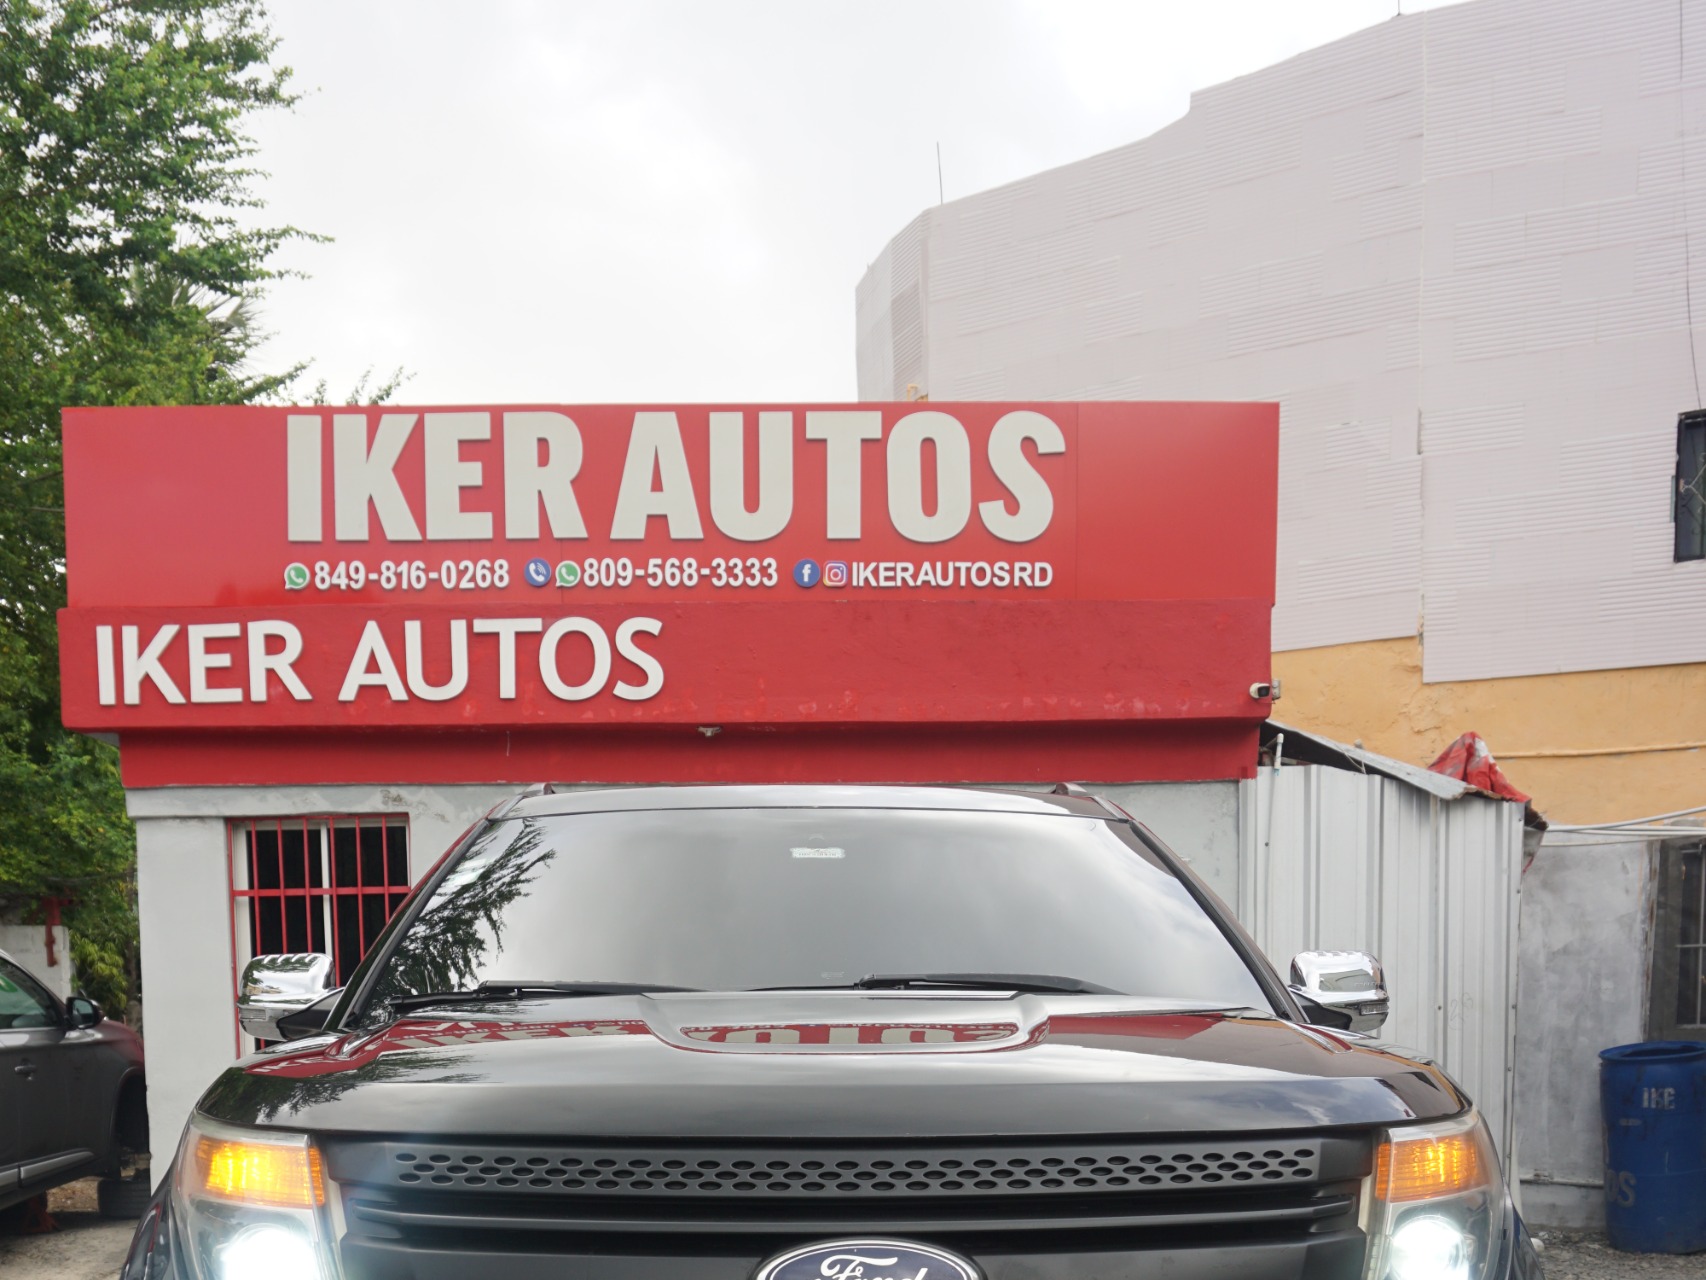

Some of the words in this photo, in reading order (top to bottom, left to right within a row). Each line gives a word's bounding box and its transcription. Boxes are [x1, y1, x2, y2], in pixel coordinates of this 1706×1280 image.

[287, 411, 588, 542] IKER
[609, 410, 1067, 543] AUTOS
[314, 558, 510, 590] 849-816-0268
[583, 557, 779, 589] 809-568-3333
[96, 619, 313, 706] IKER
[338, 616, 665, 702] AUTOS
